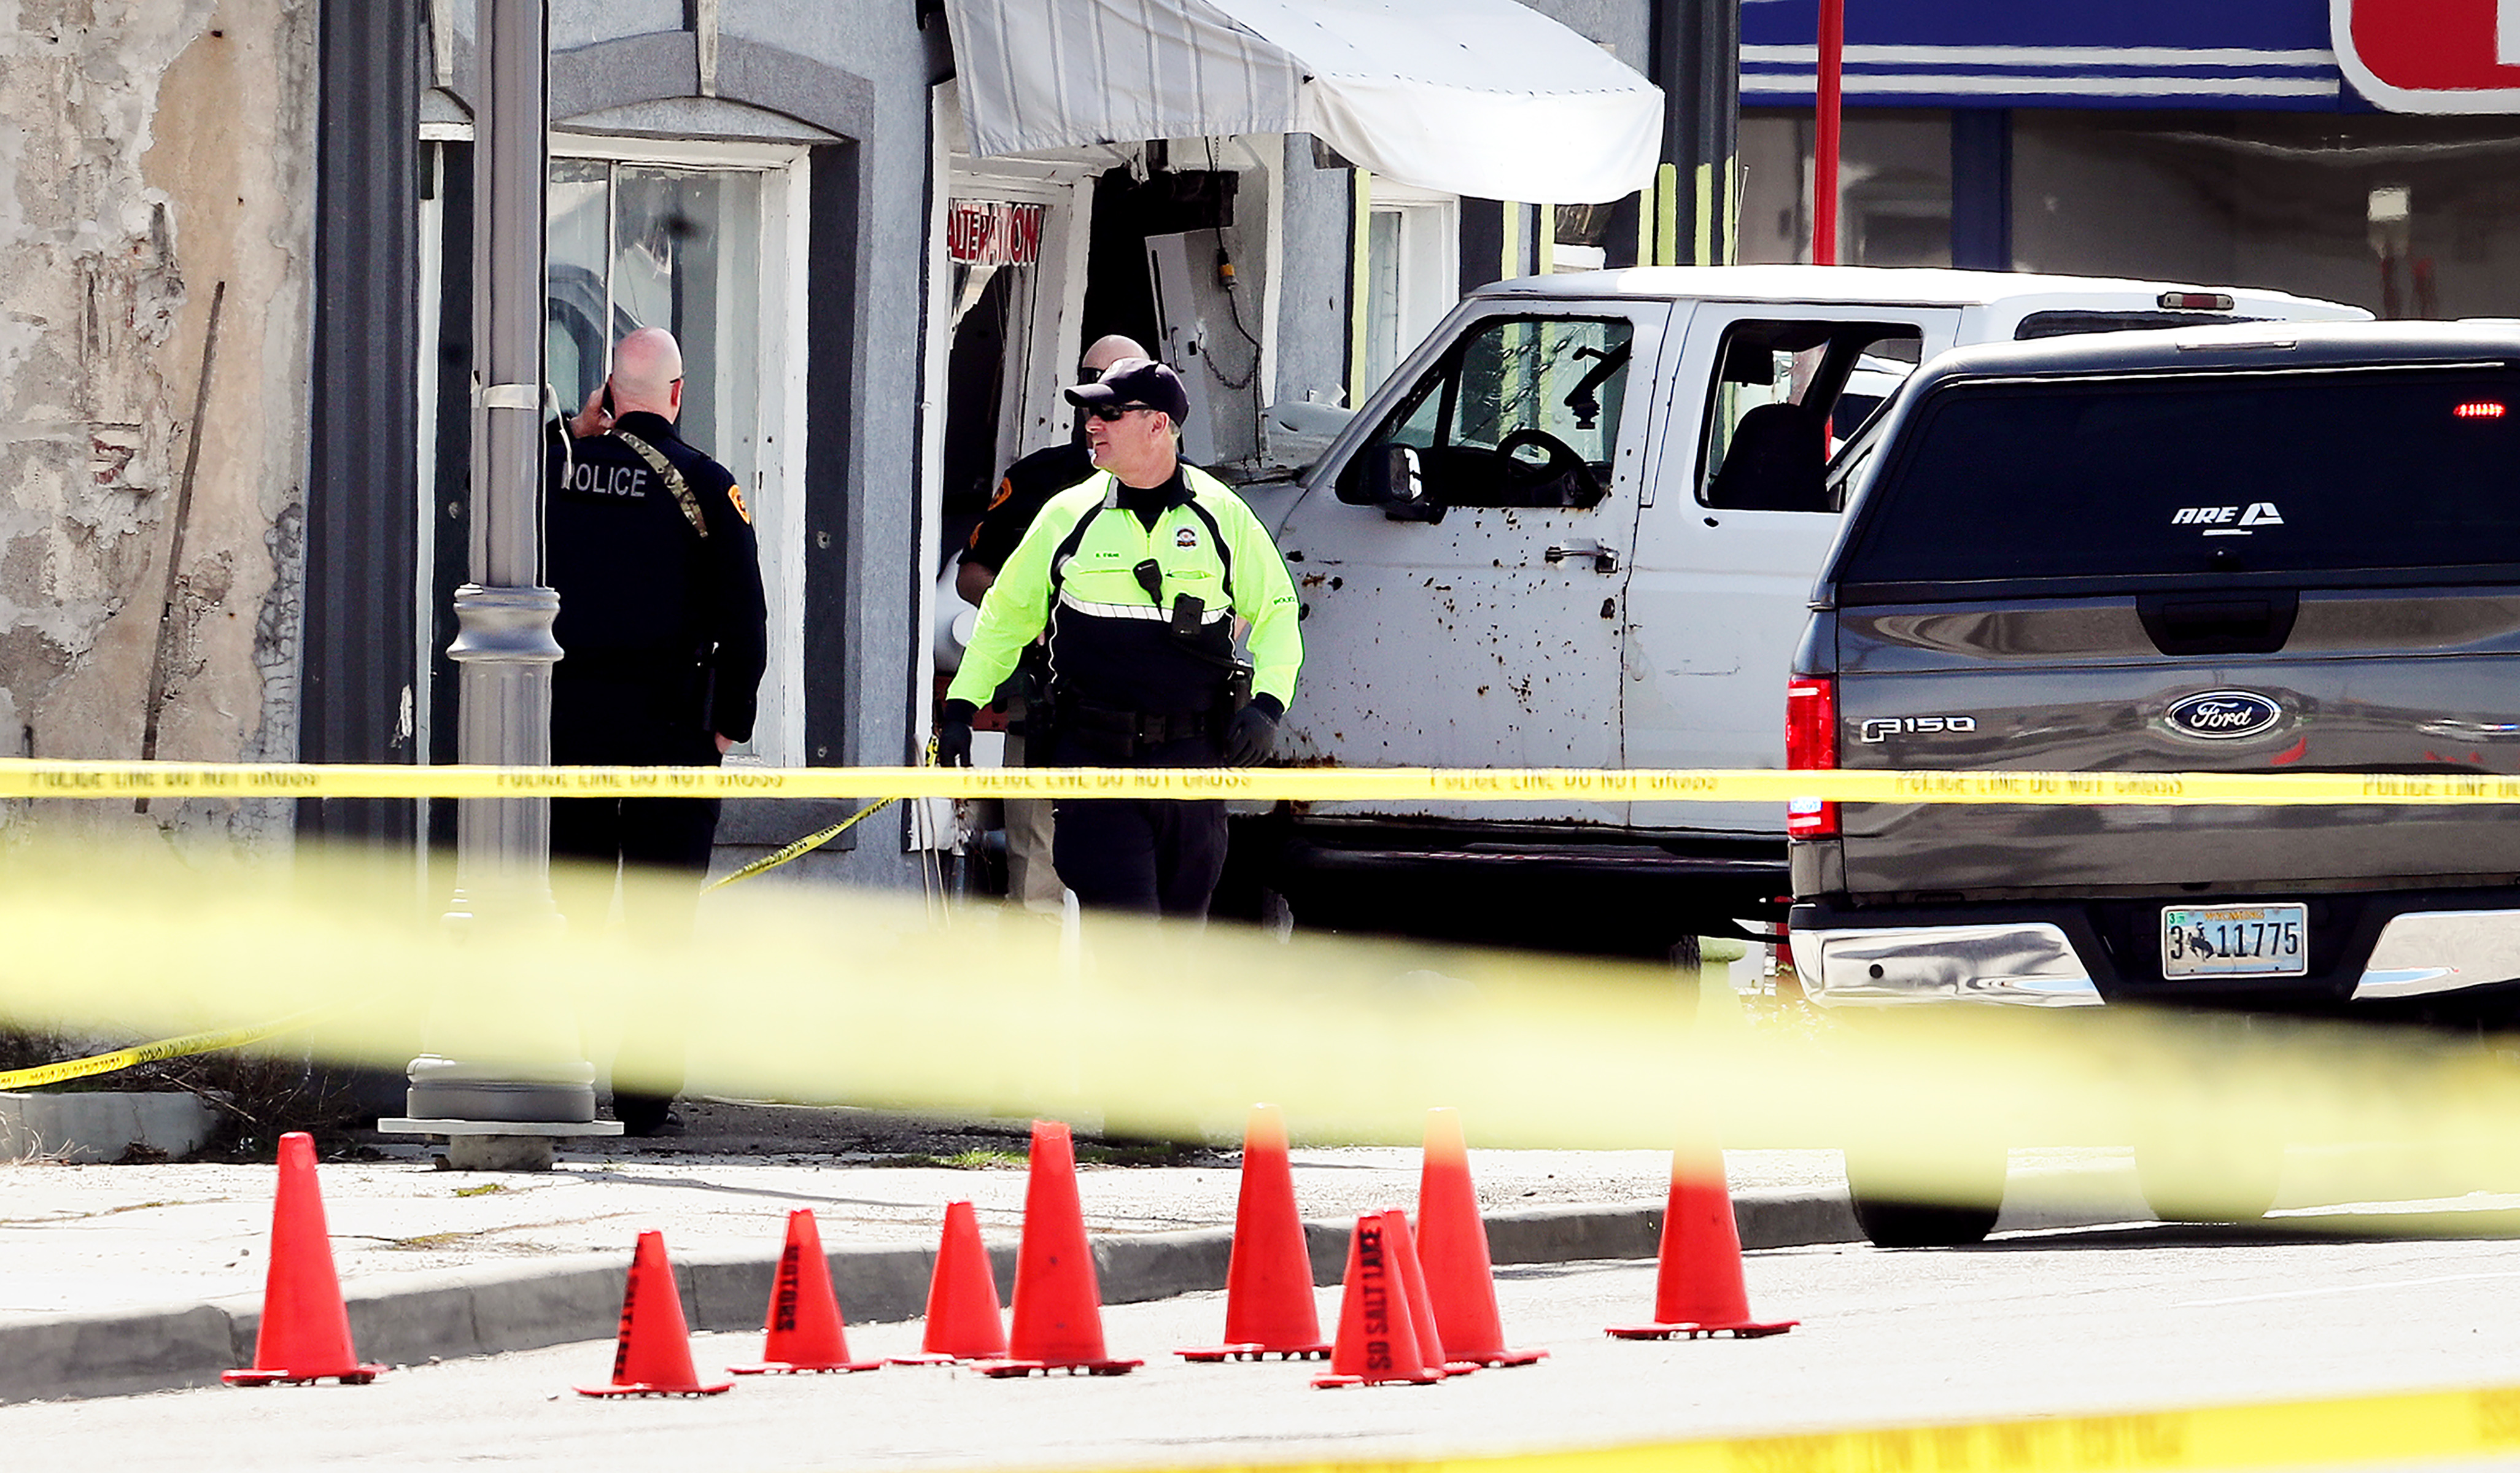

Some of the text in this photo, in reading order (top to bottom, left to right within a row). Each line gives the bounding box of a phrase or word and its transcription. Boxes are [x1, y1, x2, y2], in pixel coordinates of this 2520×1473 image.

[561, 462, 647, 497] POLICE
[2171, 506, 2239, 524] ARE
[2190, 702, 2253, 728] Ford
[2170, 922, 2298, 959] 3 11775
[1362, 1285, 1389, 1334] SALT
[1366, 1341, 1392, 1370] SO
